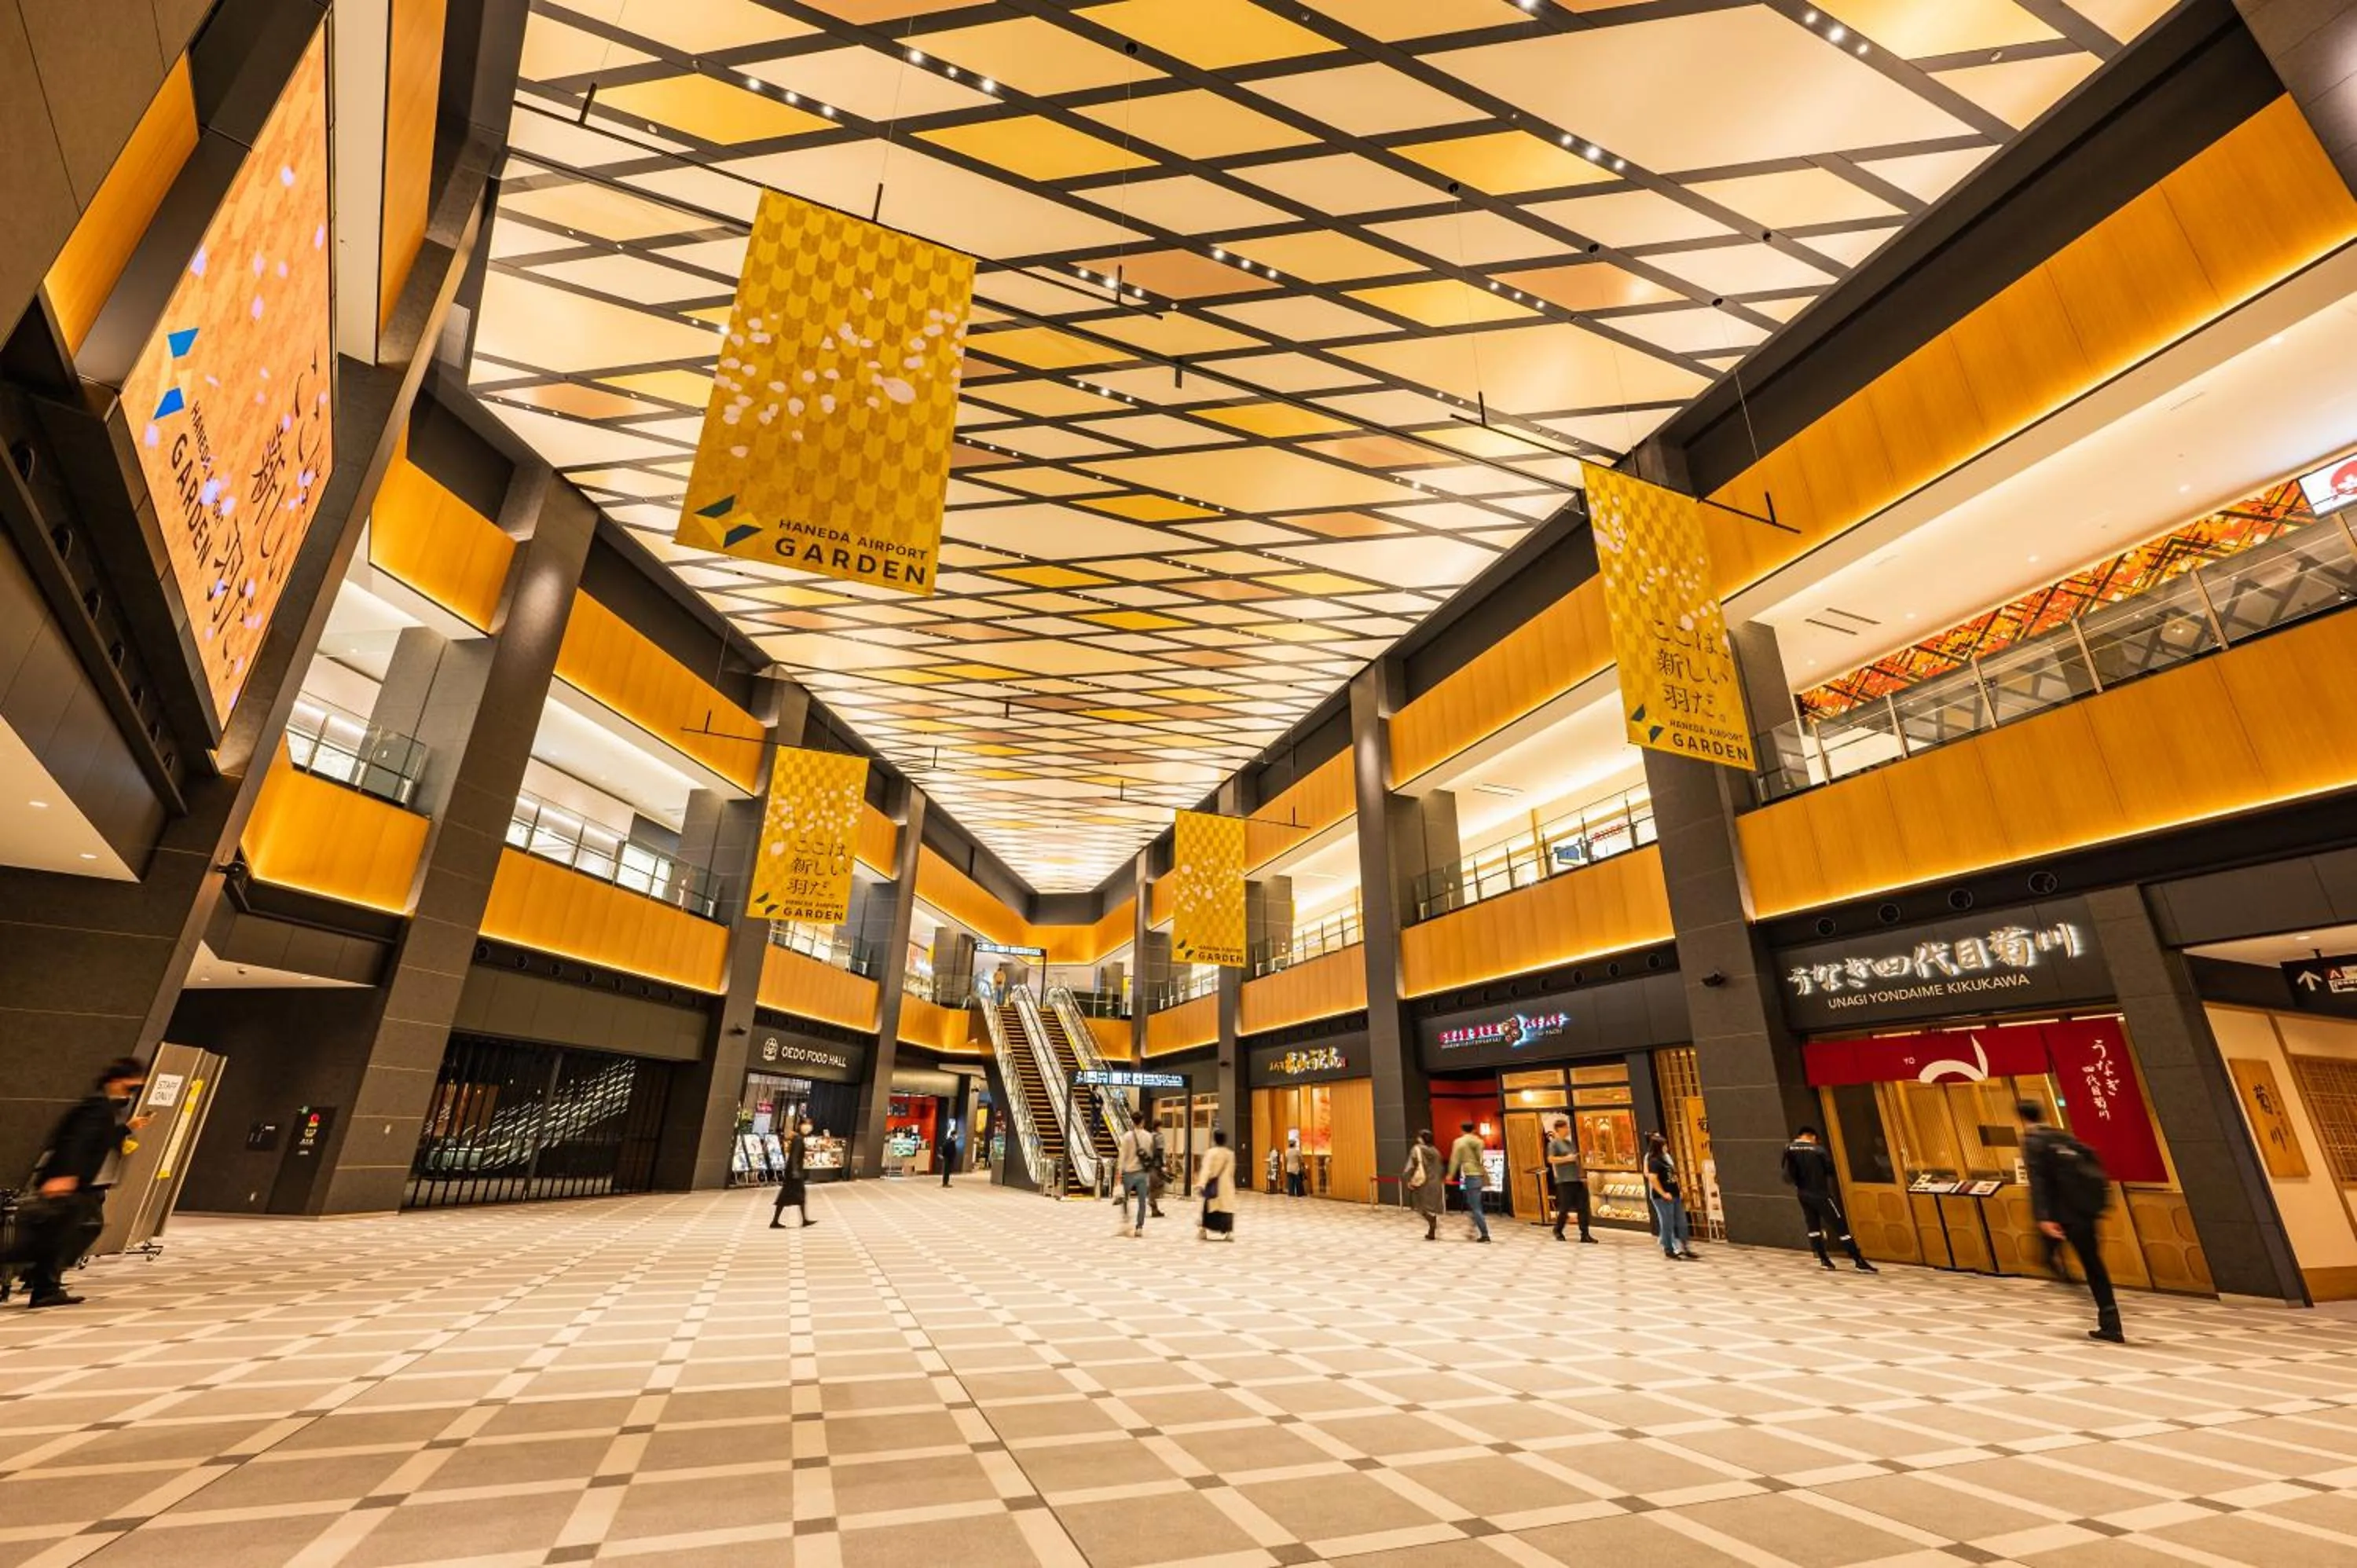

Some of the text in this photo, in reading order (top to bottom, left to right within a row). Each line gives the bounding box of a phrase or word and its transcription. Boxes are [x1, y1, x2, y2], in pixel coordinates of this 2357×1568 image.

[171, 433, 212, 570] GARDEN
[779, 519, 927, 560] HANEDA AIRPORT
[775, 538, 926, 584] GARDEN
[1653, 619, 1729, 659] ここは、
[1658, 648, 1728, 684] 新しい
[1662, 683, 1726, 722] 羽だ。
[1670, 720, 1705, 734] HANEDA
[1673, 732, 1749, 760] GARDEN
[792, 857, 848, 876] 新しい
[783, 907, 843, 921] GARDEN
[1198, 951, 1244, 962] GARDEN
[1828, 973, 2030, 1009] UNAGI YONDAIME KIKUKAWA
[781, 1046, 846, 1068] OEDO FOOD HALL
[2091, 1039, 2120, 1096] うなぎ
[155, 1091, 173, 1101] ONLY
[158, 1080, 179, 1090] STAFF
